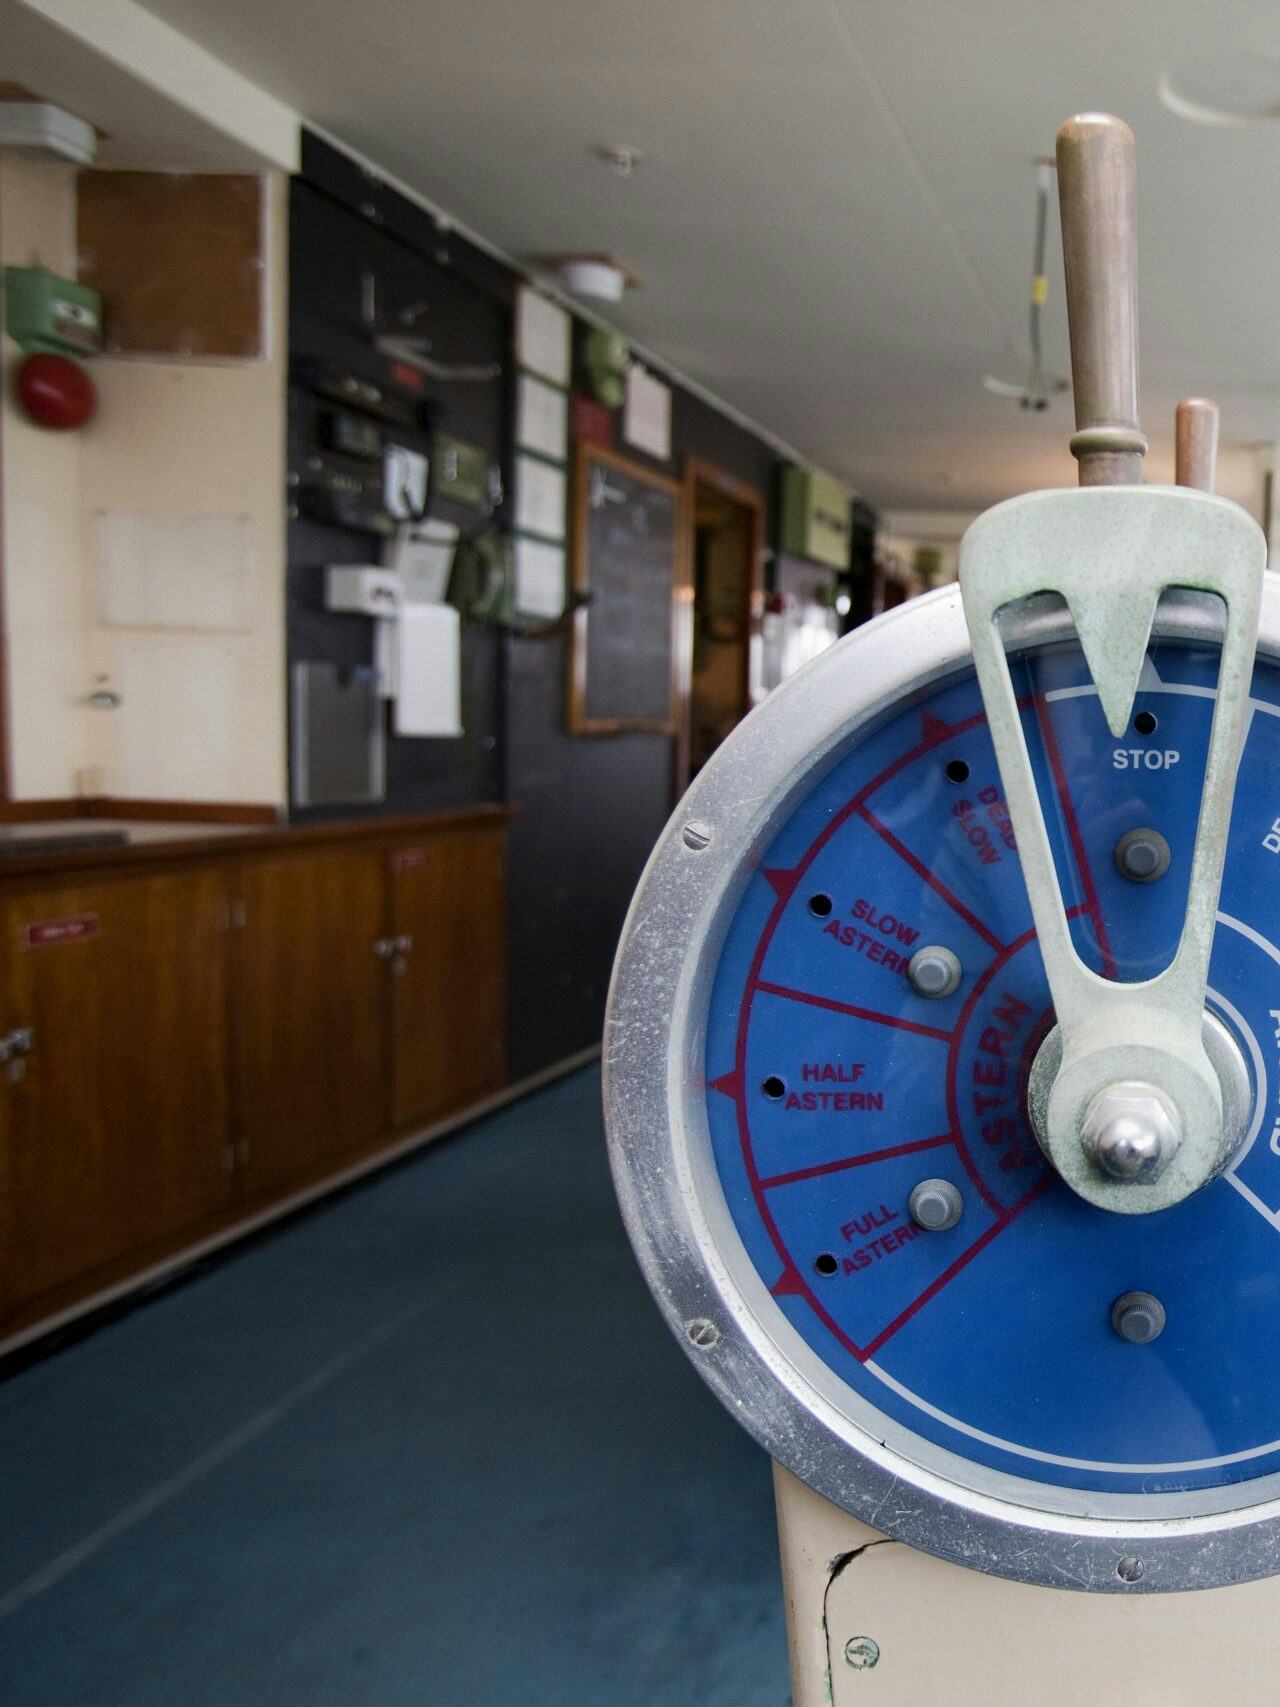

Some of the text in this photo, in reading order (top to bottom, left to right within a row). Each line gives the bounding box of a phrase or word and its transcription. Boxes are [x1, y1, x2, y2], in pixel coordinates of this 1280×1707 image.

[1112, 749, 1181, 770] STOP
[952, 799, 1003, 865] SLOW
[851, 898, 922, 947] SLOW
[802, 1063, 866, 1083] HALF
[973, 992, 1033, 1171] ASTERN
[784, 1092, 883, 1112] ASTERN
[840, 1204, 899, 1243] FULL
